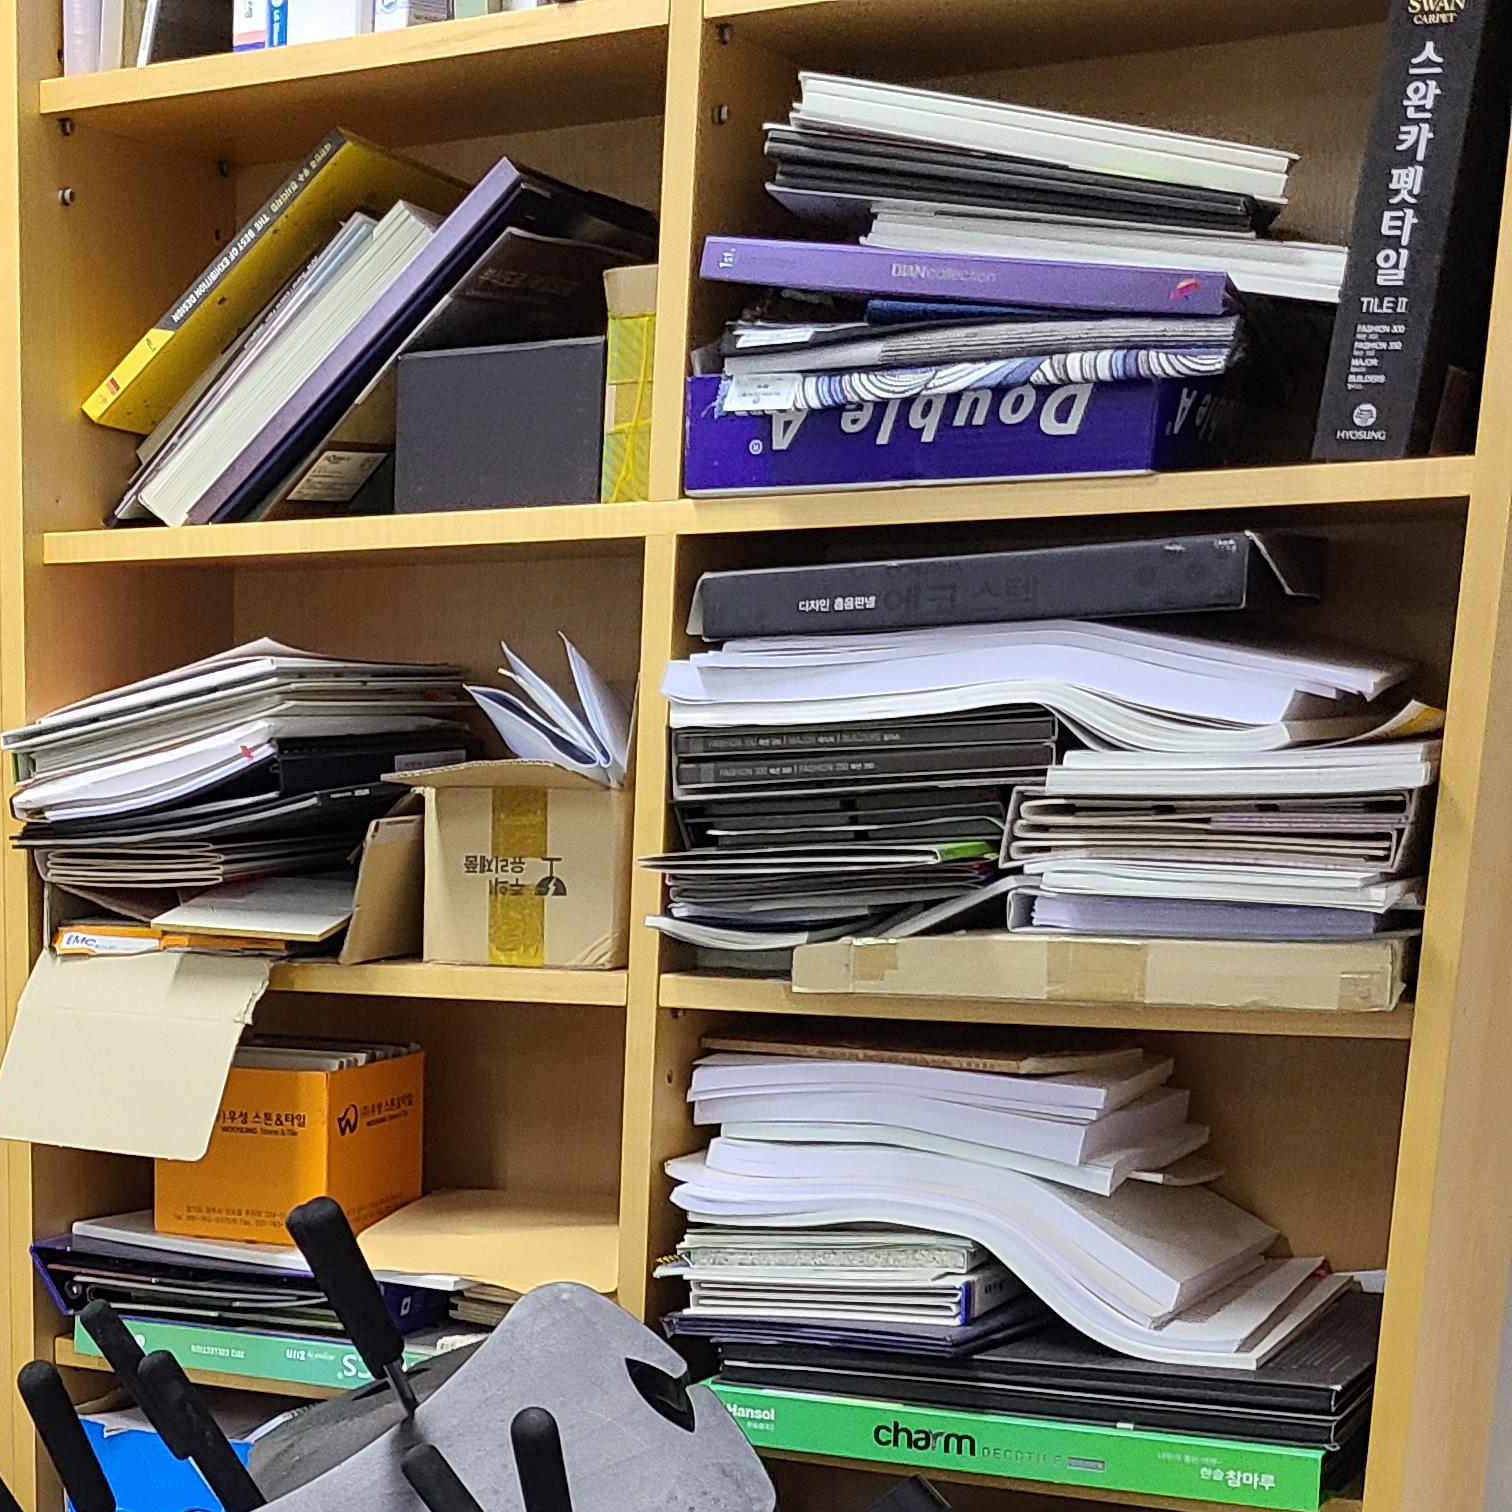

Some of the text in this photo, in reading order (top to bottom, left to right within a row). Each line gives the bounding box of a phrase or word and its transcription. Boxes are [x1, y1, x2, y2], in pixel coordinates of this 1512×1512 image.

[1374, 40, 1444, 286] 스완카펫타일
[171, 213, 271, 323] THE BEST OF EXHIBITION DESIGN
[1360, 296, 1395, 313] TILE
[841, 383, 1093, 445] Double
[1336, 430, 1387, 440] HYOSUNG
[798, 597, 831, 613] 디자인
[463, 854, 526, 876] 유리제품
[252, 1112, 306, 1128] 스톤&타일
[726, 1403, 775, 1422] Hansol
[874, 1421, 976, 1457] charm
[1226, 1467, 1276, 1491] 참마루
